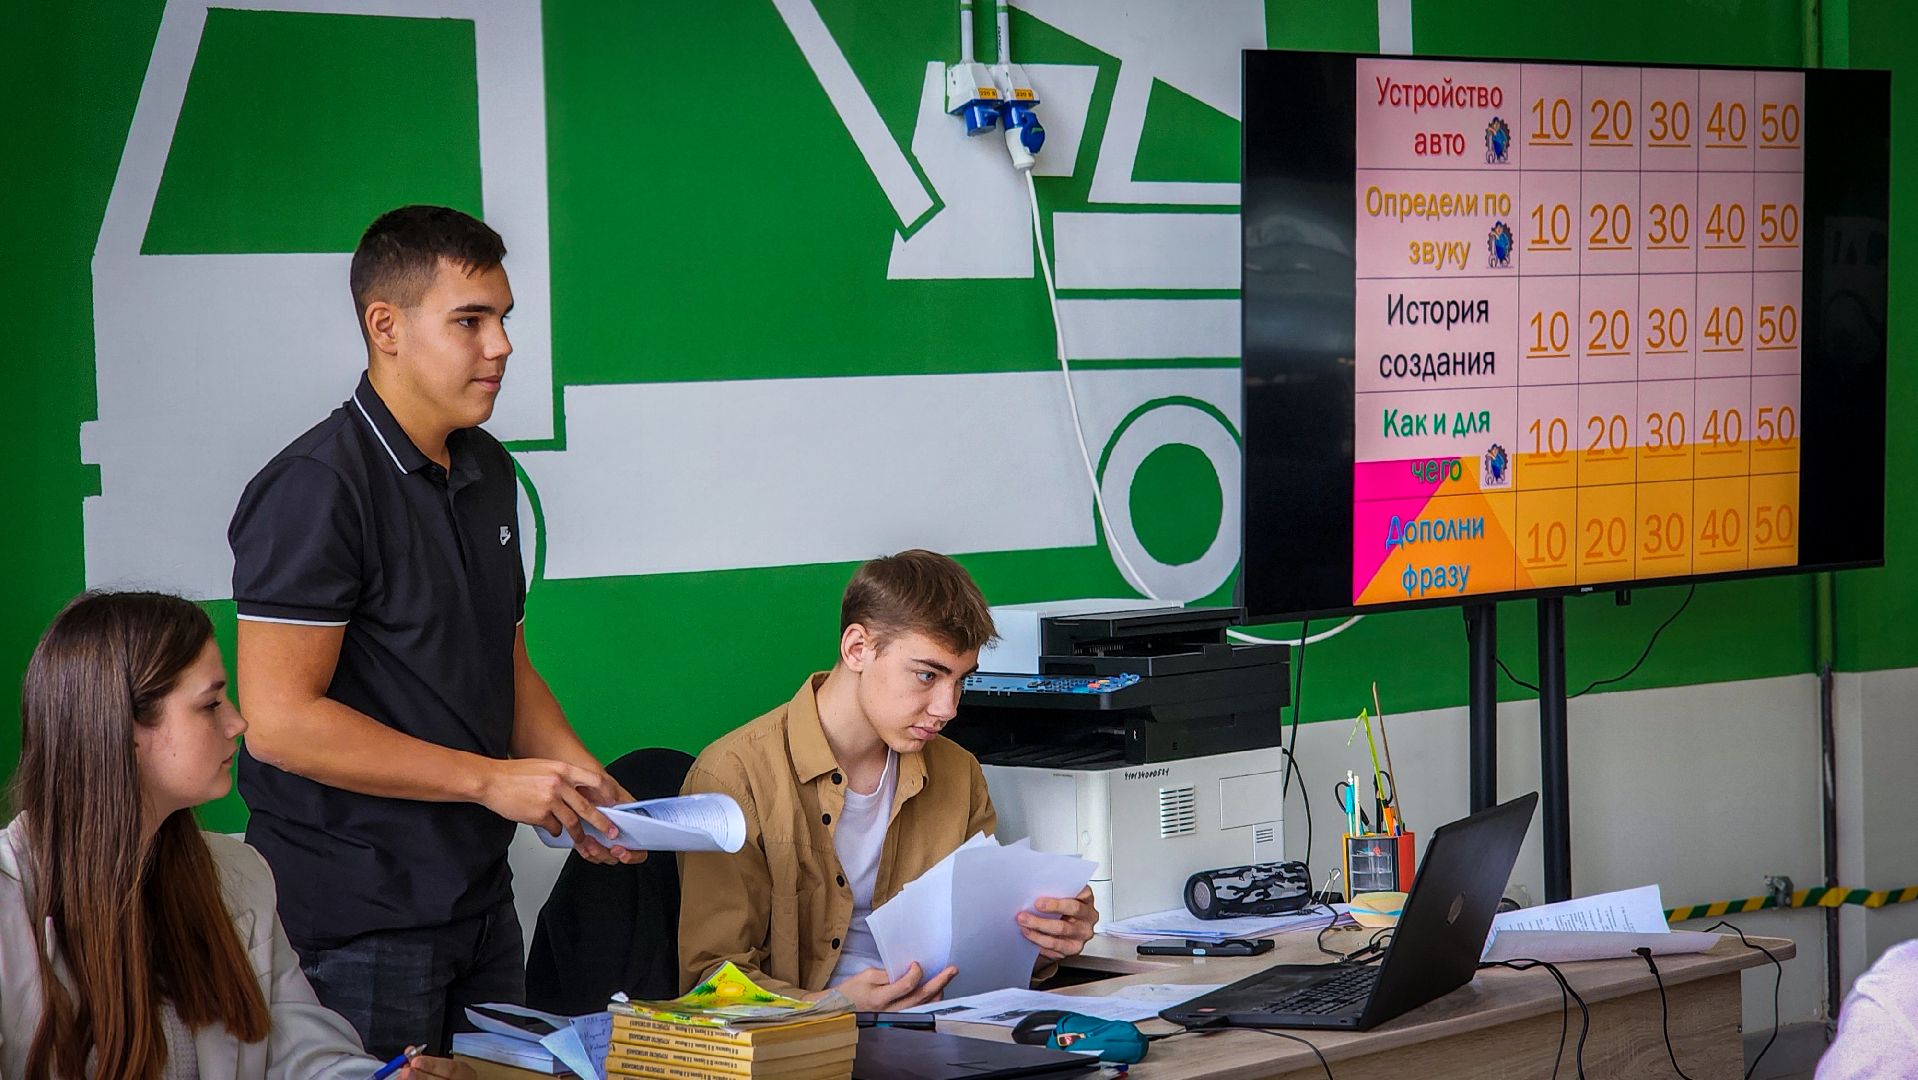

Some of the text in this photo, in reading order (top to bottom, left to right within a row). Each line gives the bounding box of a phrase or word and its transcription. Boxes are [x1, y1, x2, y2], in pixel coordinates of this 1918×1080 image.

[1376, 76, 1503, 113] Устройство
[1531, 98, 1571, 139] 10
[1590, 99, 1632, 140] 20
[1649, 101, 1690, 141] 30
[1707, 102, 1746, 142] 40
[1760, 104, 1800, 142] 50
[1415, 133, 1465, 156] авто
[1366, 185, 1511, 223] Определи по
[1531, 204, 1570, 244] 10
[1589, 204, 1631, 244] 20
[1648, 204, 1689, 243] 30
[1706, 204, 1745, 243] 40
[1760, 204, 1798, 243] 50
[1409, 240, 1471, 270] звуку
[1388, 294, 1489, 330] История
[1530, 311, 1569, 352] 10
[1588, 310, 1629, 350] 20
[1646, 308, 1687, 348] 30
[1704, 306, 1743, 346] 40
[1758, 305, 1797, 345] 50
[1380, 352, 1495, 382] создания
[1383, 409, 1490, 438] Как и для
[1528, 418, 1567, 459] 10
[1587, 415, 1628, 455] 20
[1645, 412, 1685, 451] 30
[1702, 409, 1742, 448] 40
[1757, 406, 1795, 446] 50
[1412, 460, 1462, 483] чего
[1386, 516, 1484, 550] Дополни
[1527, 521, 1566, 563] 10
[1585, 517, 1626, 558] 20
[1644, 513, 1684, 553] 30
[1701, 509, 1740, 548] 40
[1755, 505, 1793, 545] 50
[1402, 563, 1470, 596] фразу
